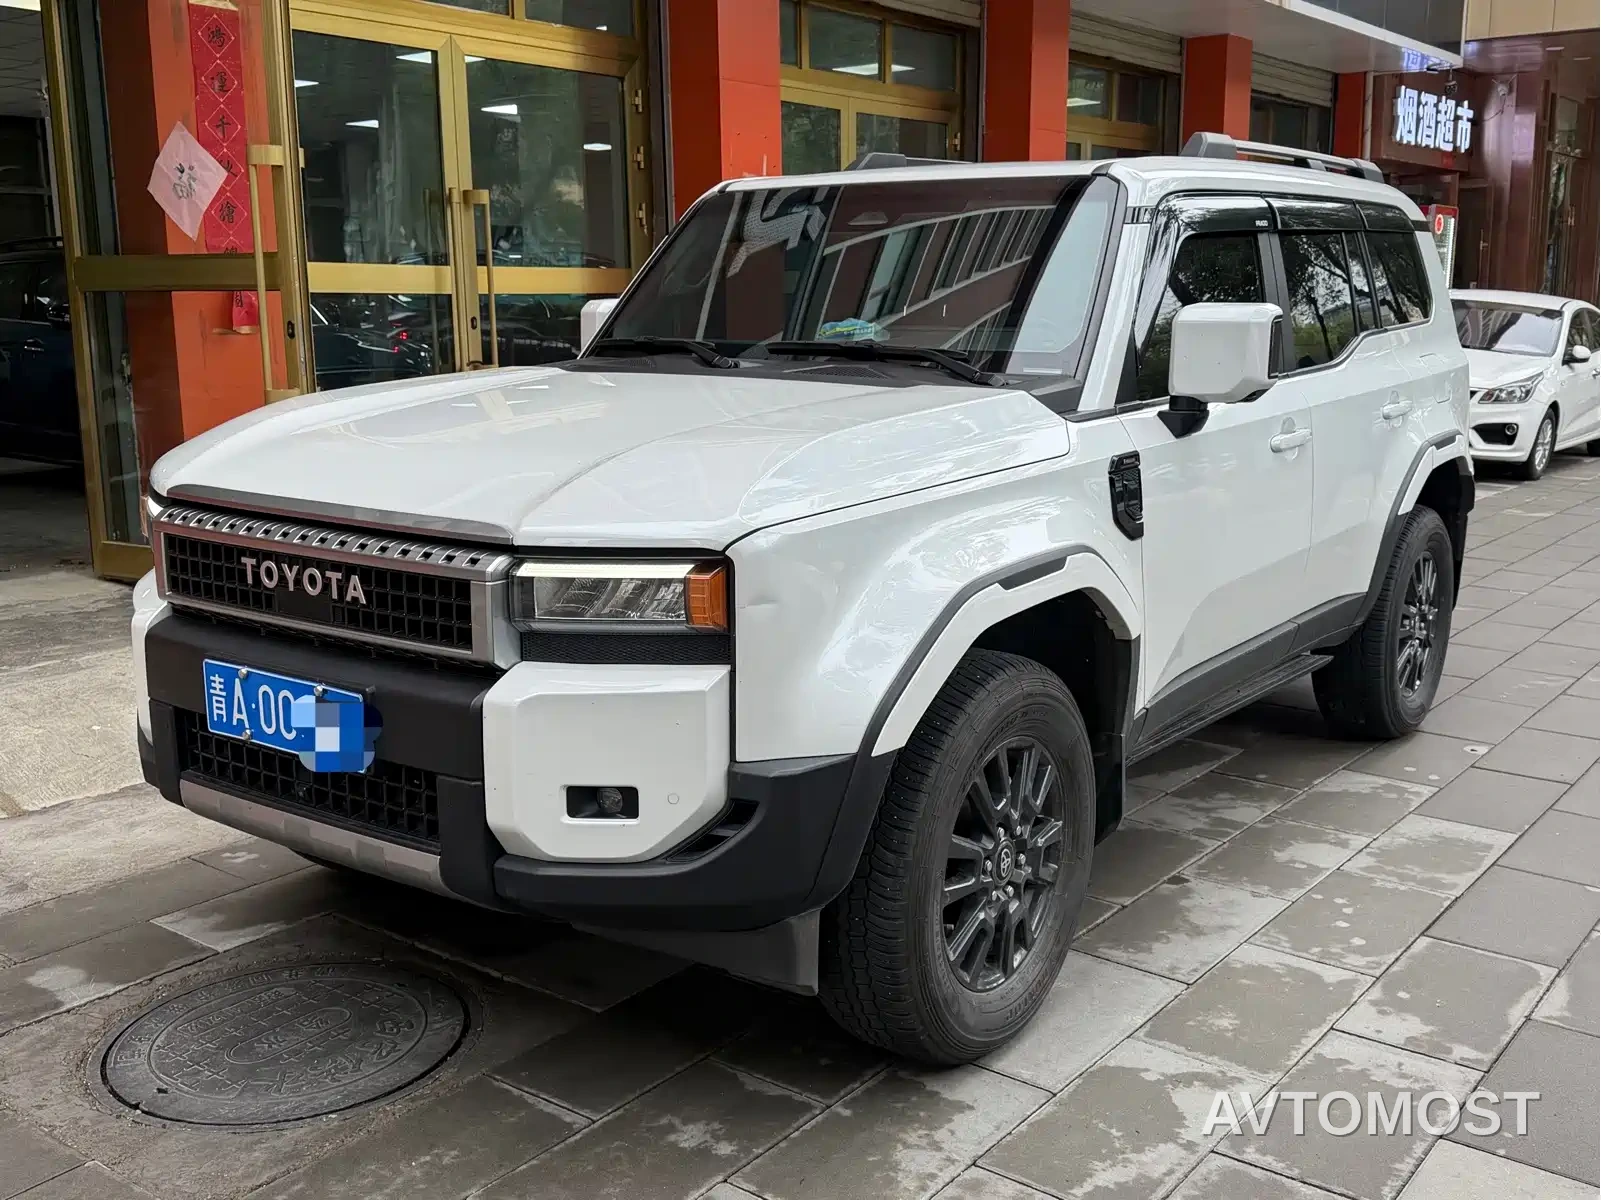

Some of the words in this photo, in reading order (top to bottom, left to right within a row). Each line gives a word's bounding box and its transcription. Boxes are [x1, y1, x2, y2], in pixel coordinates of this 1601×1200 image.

[1395, 85, 1475, 154] 烟酒超市
[241, 556, 367, 605] TOYOTA
